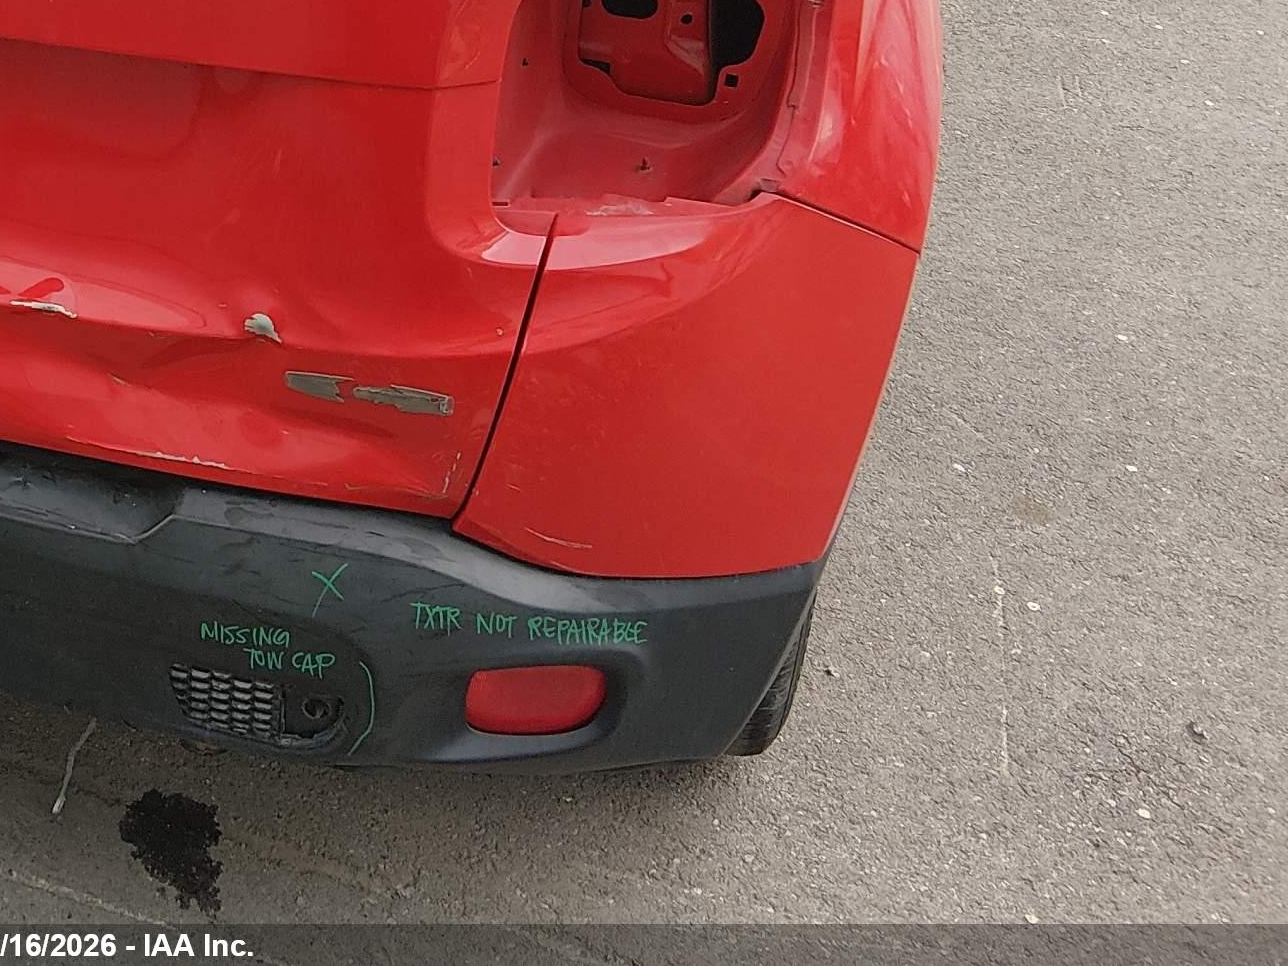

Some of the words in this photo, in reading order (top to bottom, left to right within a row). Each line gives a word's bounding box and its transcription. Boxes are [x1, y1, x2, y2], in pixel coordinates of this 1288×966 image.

[200, 620, 291, 648] MISSING
[475, 612, 518, 638] NOT
[528, 616, 649, 648] REPAIRABLE
[243, 648, 285, 670] TOW
[291, 652, 336, 680] CAP
